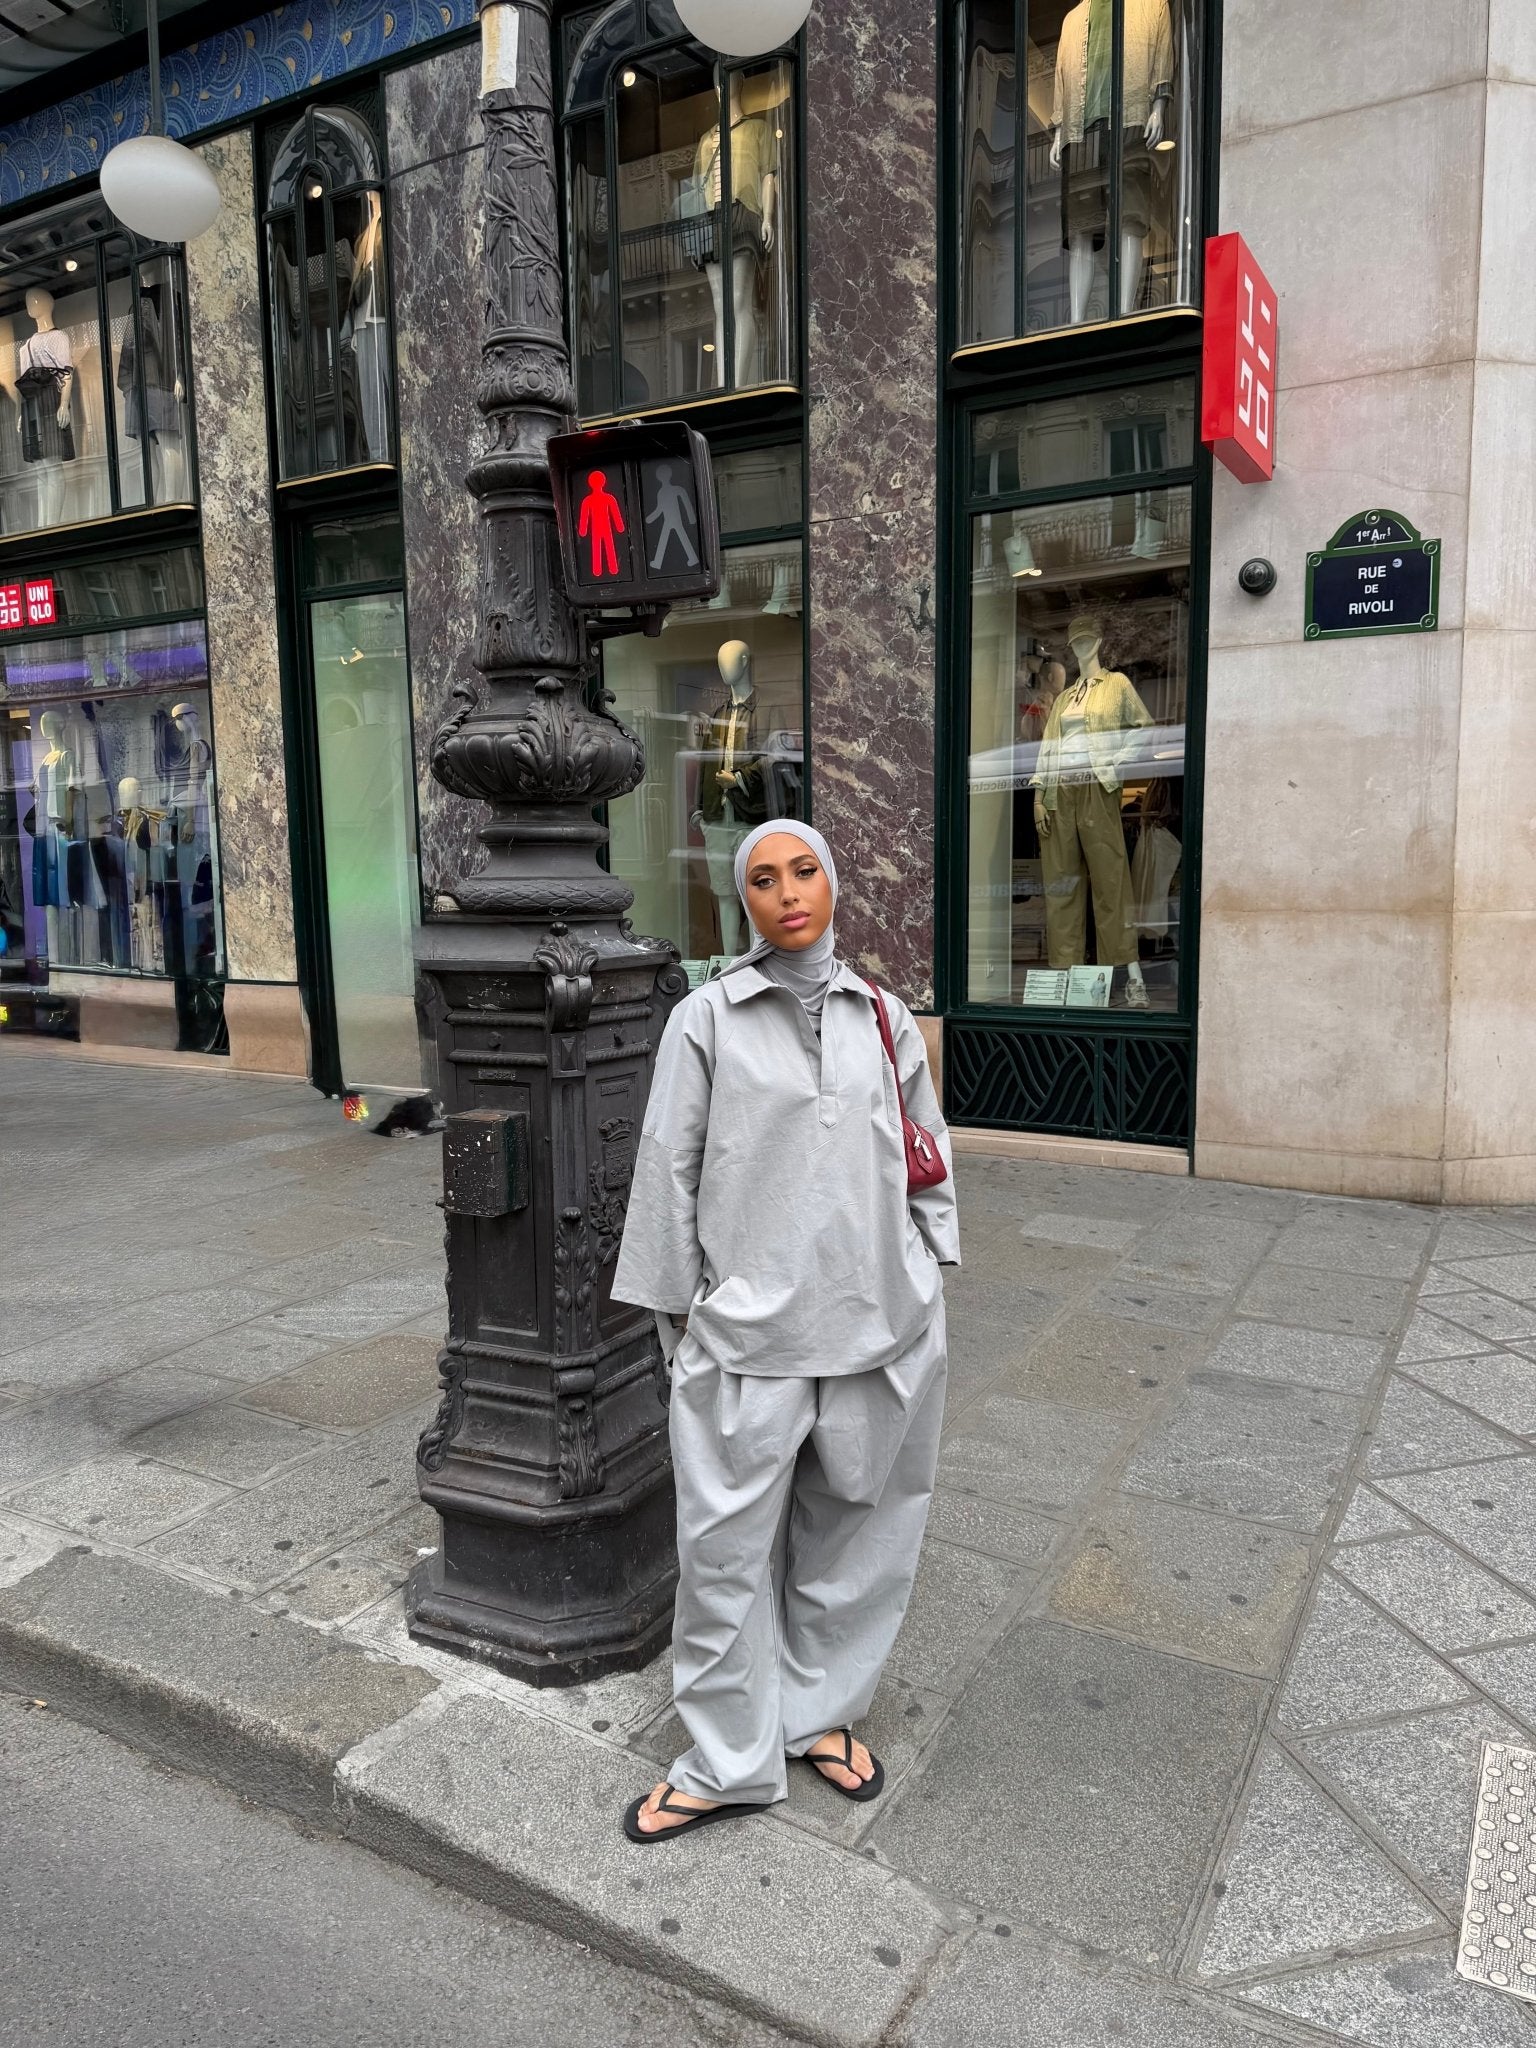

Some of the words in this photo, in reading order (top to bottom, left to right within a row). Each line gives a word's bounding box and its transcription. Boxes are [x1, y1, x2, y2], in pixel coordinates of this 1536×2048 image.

[1356, 530, 1371, 542] 1er
[1358, 565, 1387, 579] RUE
[28, 585, 49, 602] UNI
[1364, 584, 1379, 594] DE
[31, 603, 52, 622] QLO
[1348, 600, 1394, 615] RIVOLI
